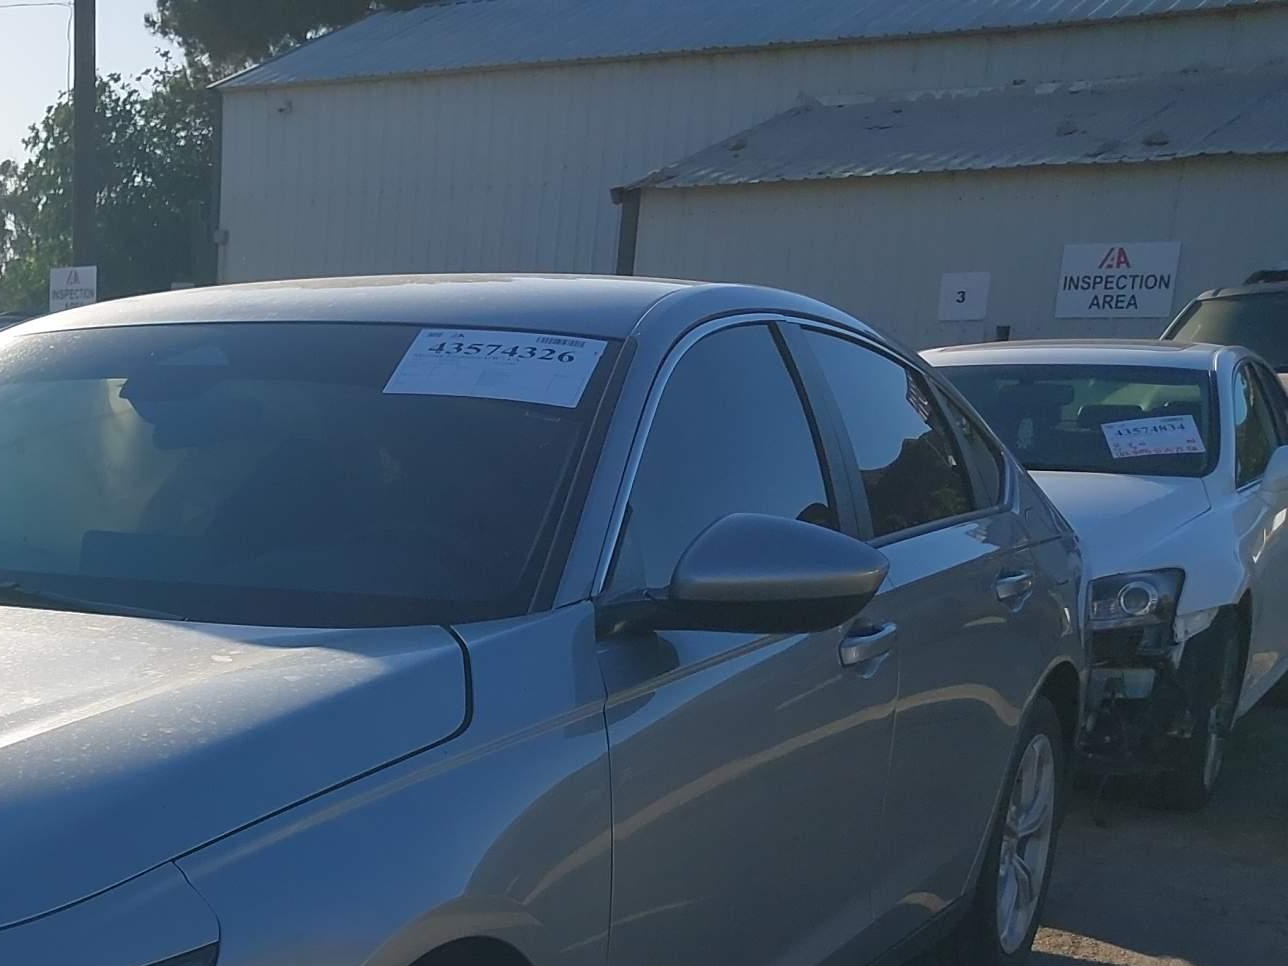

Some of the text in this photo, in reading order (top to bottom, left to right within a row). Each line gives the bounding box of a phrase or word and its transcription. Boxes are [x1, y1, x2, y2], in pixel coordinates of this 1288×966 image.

[1063, 274, 1171, 292] INSPECTION
[956, 291, 966, 304] 3
[1088, 294, 1138, 310] AREA
[428, 342, 575, 363] 43574326
